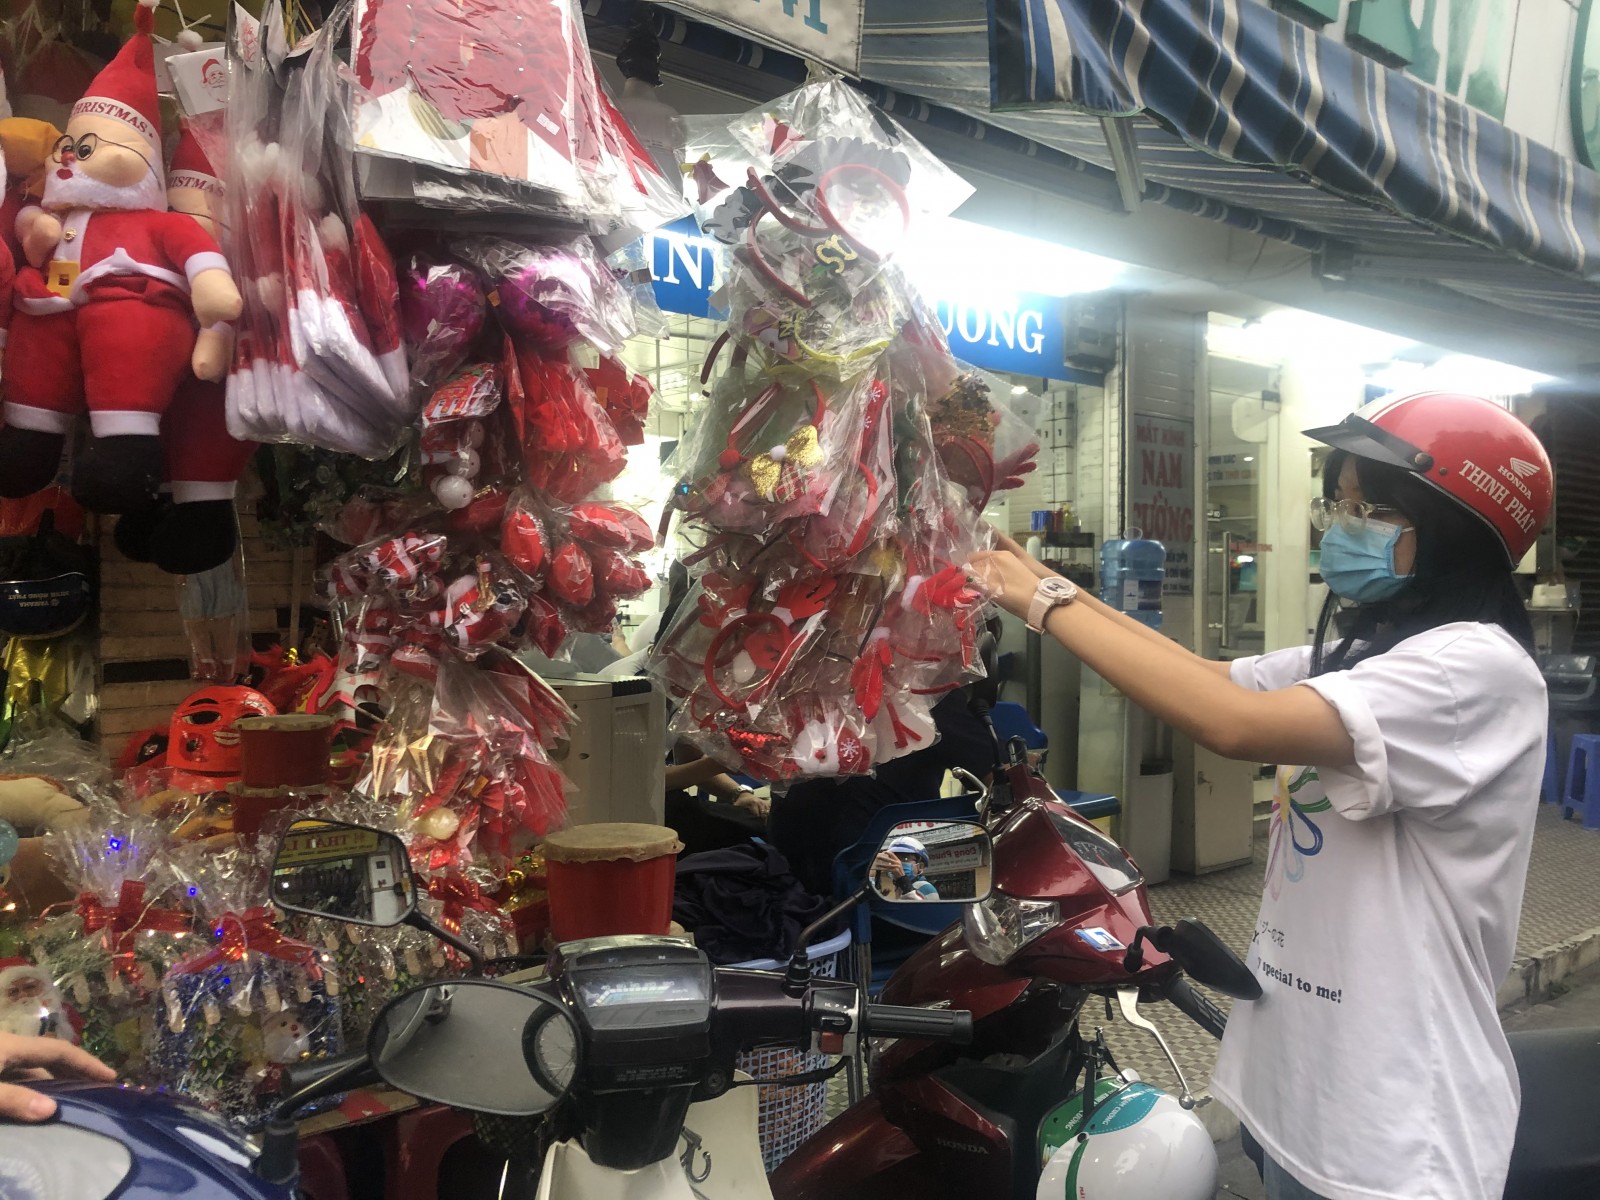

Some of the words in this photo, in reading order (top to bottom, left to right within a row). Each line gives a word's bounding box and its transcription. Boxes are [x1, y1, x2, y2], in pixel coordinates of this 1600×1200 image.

[72, 101, 148, 133] HRISTMAS
[1142, 450, 1183, 488] NAM
[1497, 465, 1532, 500] HONDA
[1458, 459, 1511, 505] THỊNH
[1504, 496, 1537, 534] PHÁT
[1262, 961, 1293, 987] special
[1296, 977, 1312, 993] to
[1315, 985, 1342, 1004] me!
